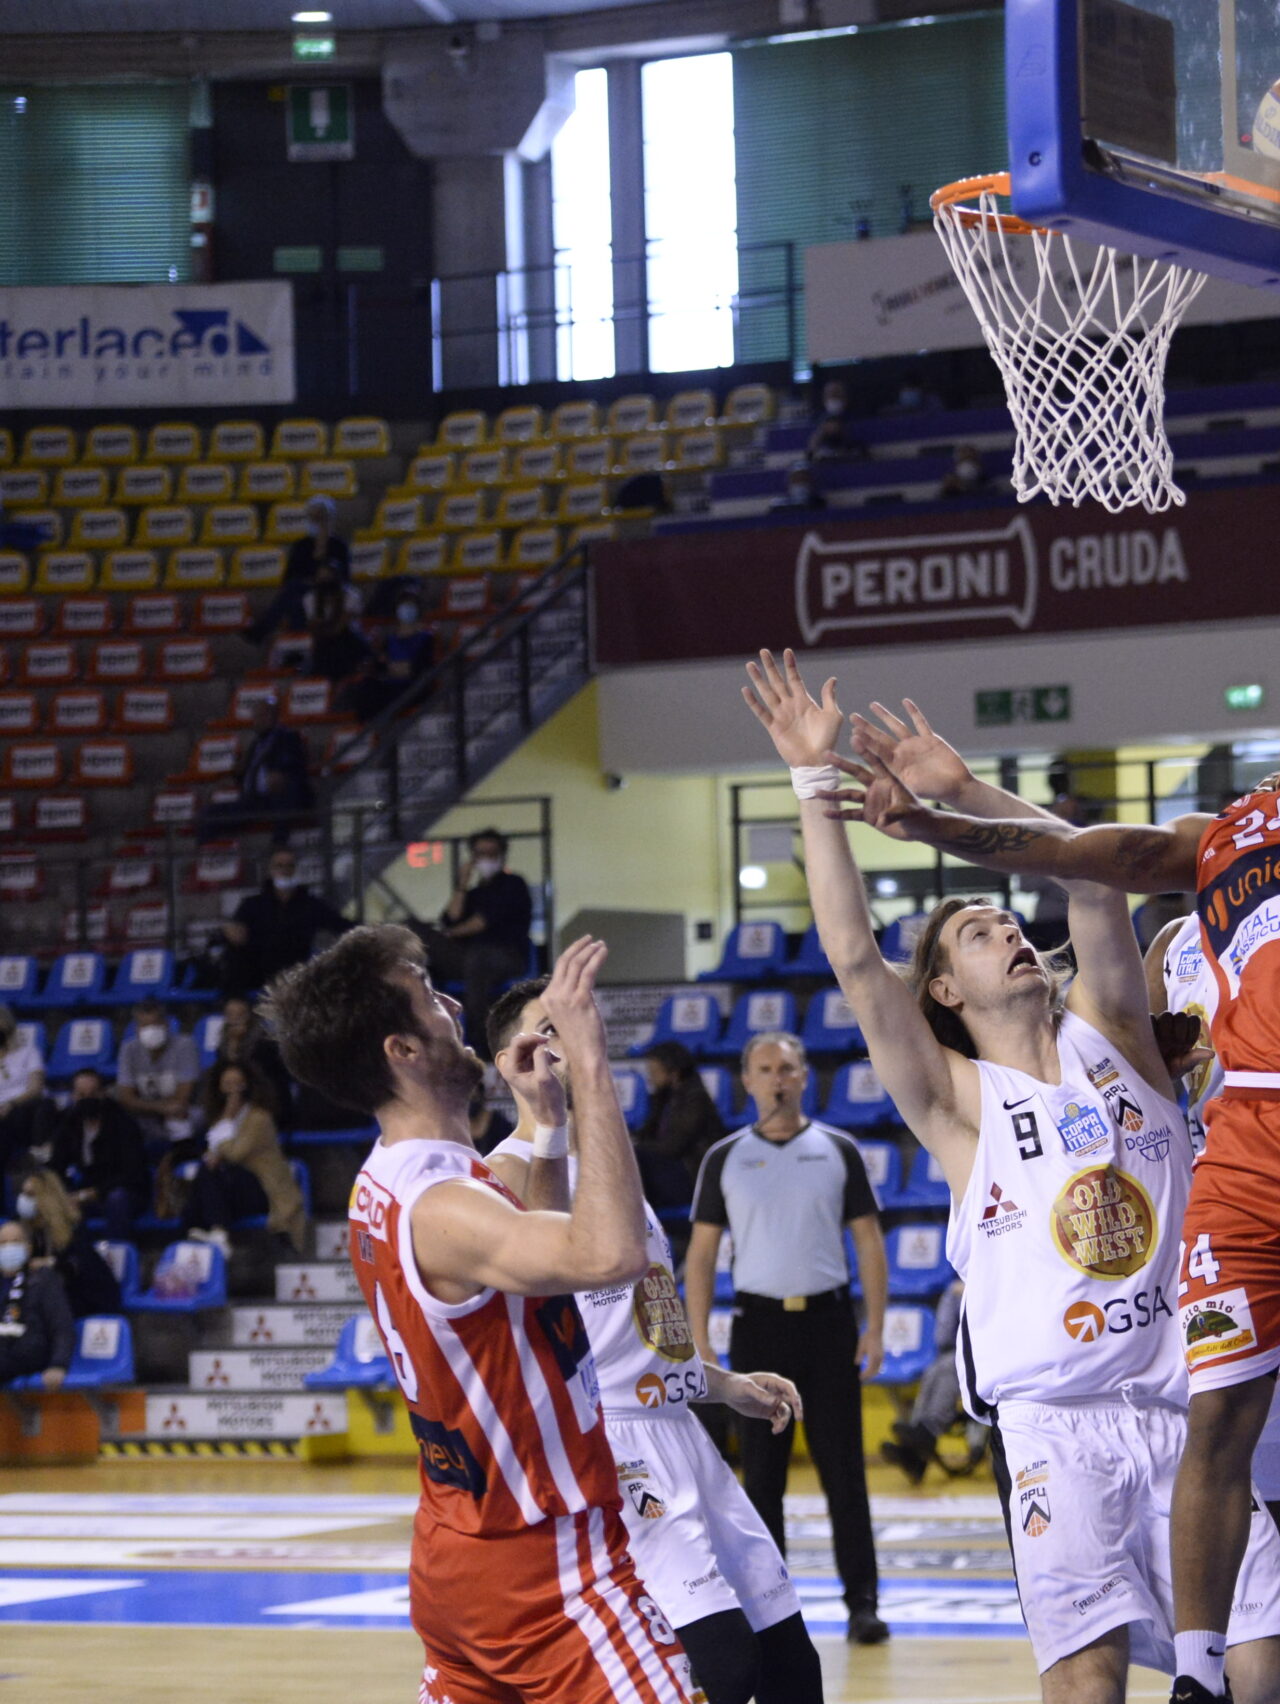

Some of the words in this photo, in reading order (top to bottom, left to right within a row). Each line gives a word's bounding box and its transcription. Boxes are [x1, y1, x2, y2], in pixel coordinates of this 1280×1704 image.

[821, 549, 1010, 609] PERONI
[1049, 528, 1189, 591] CRUDA
[1011, 1111, 1043, 1161] 9
[1061, 1113, 1100, 1140] COPPA
[1067, 1125, 1106, 1151] ITALIA
[1073, 1177, 1122, 1211] OLD
[977, 1209, 1028, 1232] MITSUBISHI
[987, 1220, 1023, 1239] MOTORS
[1069, 1202, 1136, 1240] WILD
[1072, 1226, 1144, 1267] WEST
[593, 1293, 628, 1308] MOTORS
[1103, 1286, 1173, 1334] GSA
[1020, 1486, 1047, 1505] APU
[637, 1596, 677, 1646] 8
